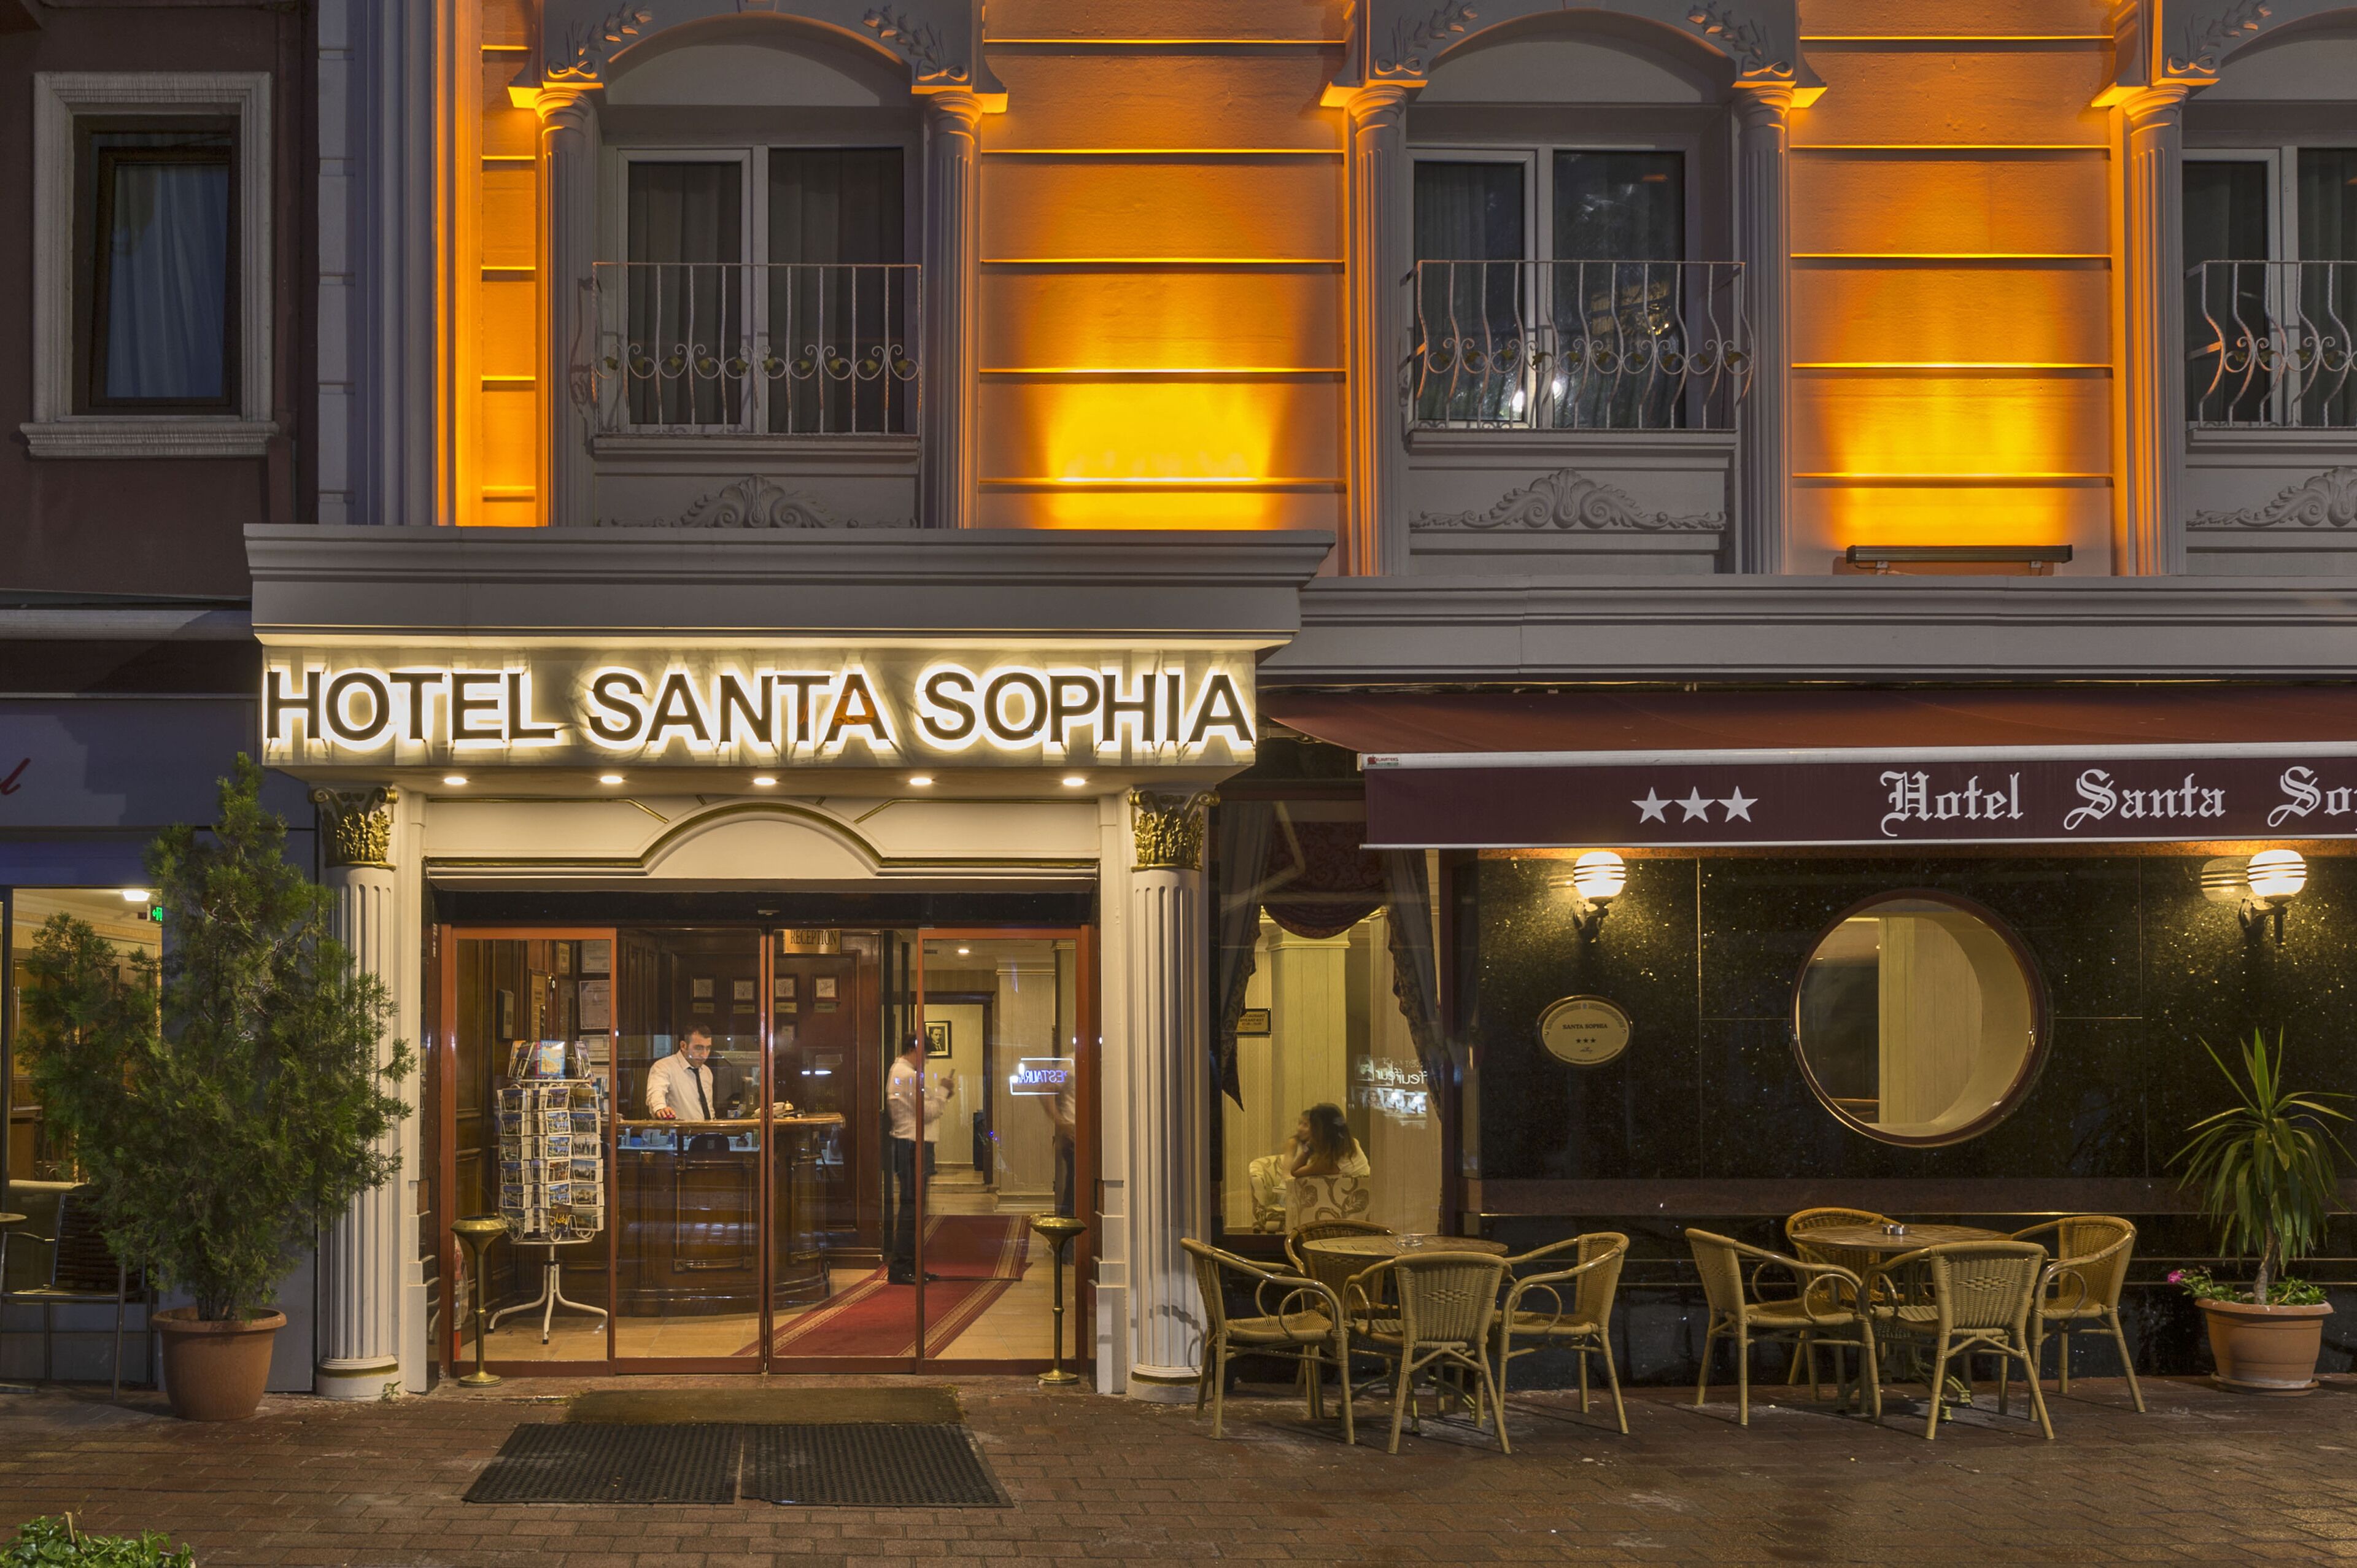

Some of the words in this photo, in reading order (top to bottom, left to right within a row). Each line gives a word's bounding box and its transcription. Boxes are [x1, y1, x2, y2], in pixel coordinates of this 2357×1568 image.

[267, 671, 555, 741] HOTEL
[588, 673, 890, 743] SANTA
[922, 672, 1255, 743] SOPHIA
[1879, 770, 2024, 837] Hotel
[2063, 768, 2226, 830] Santa
[2267, 766, 2357, 830] So
[790, 929, 837, 945] RECEPTION
